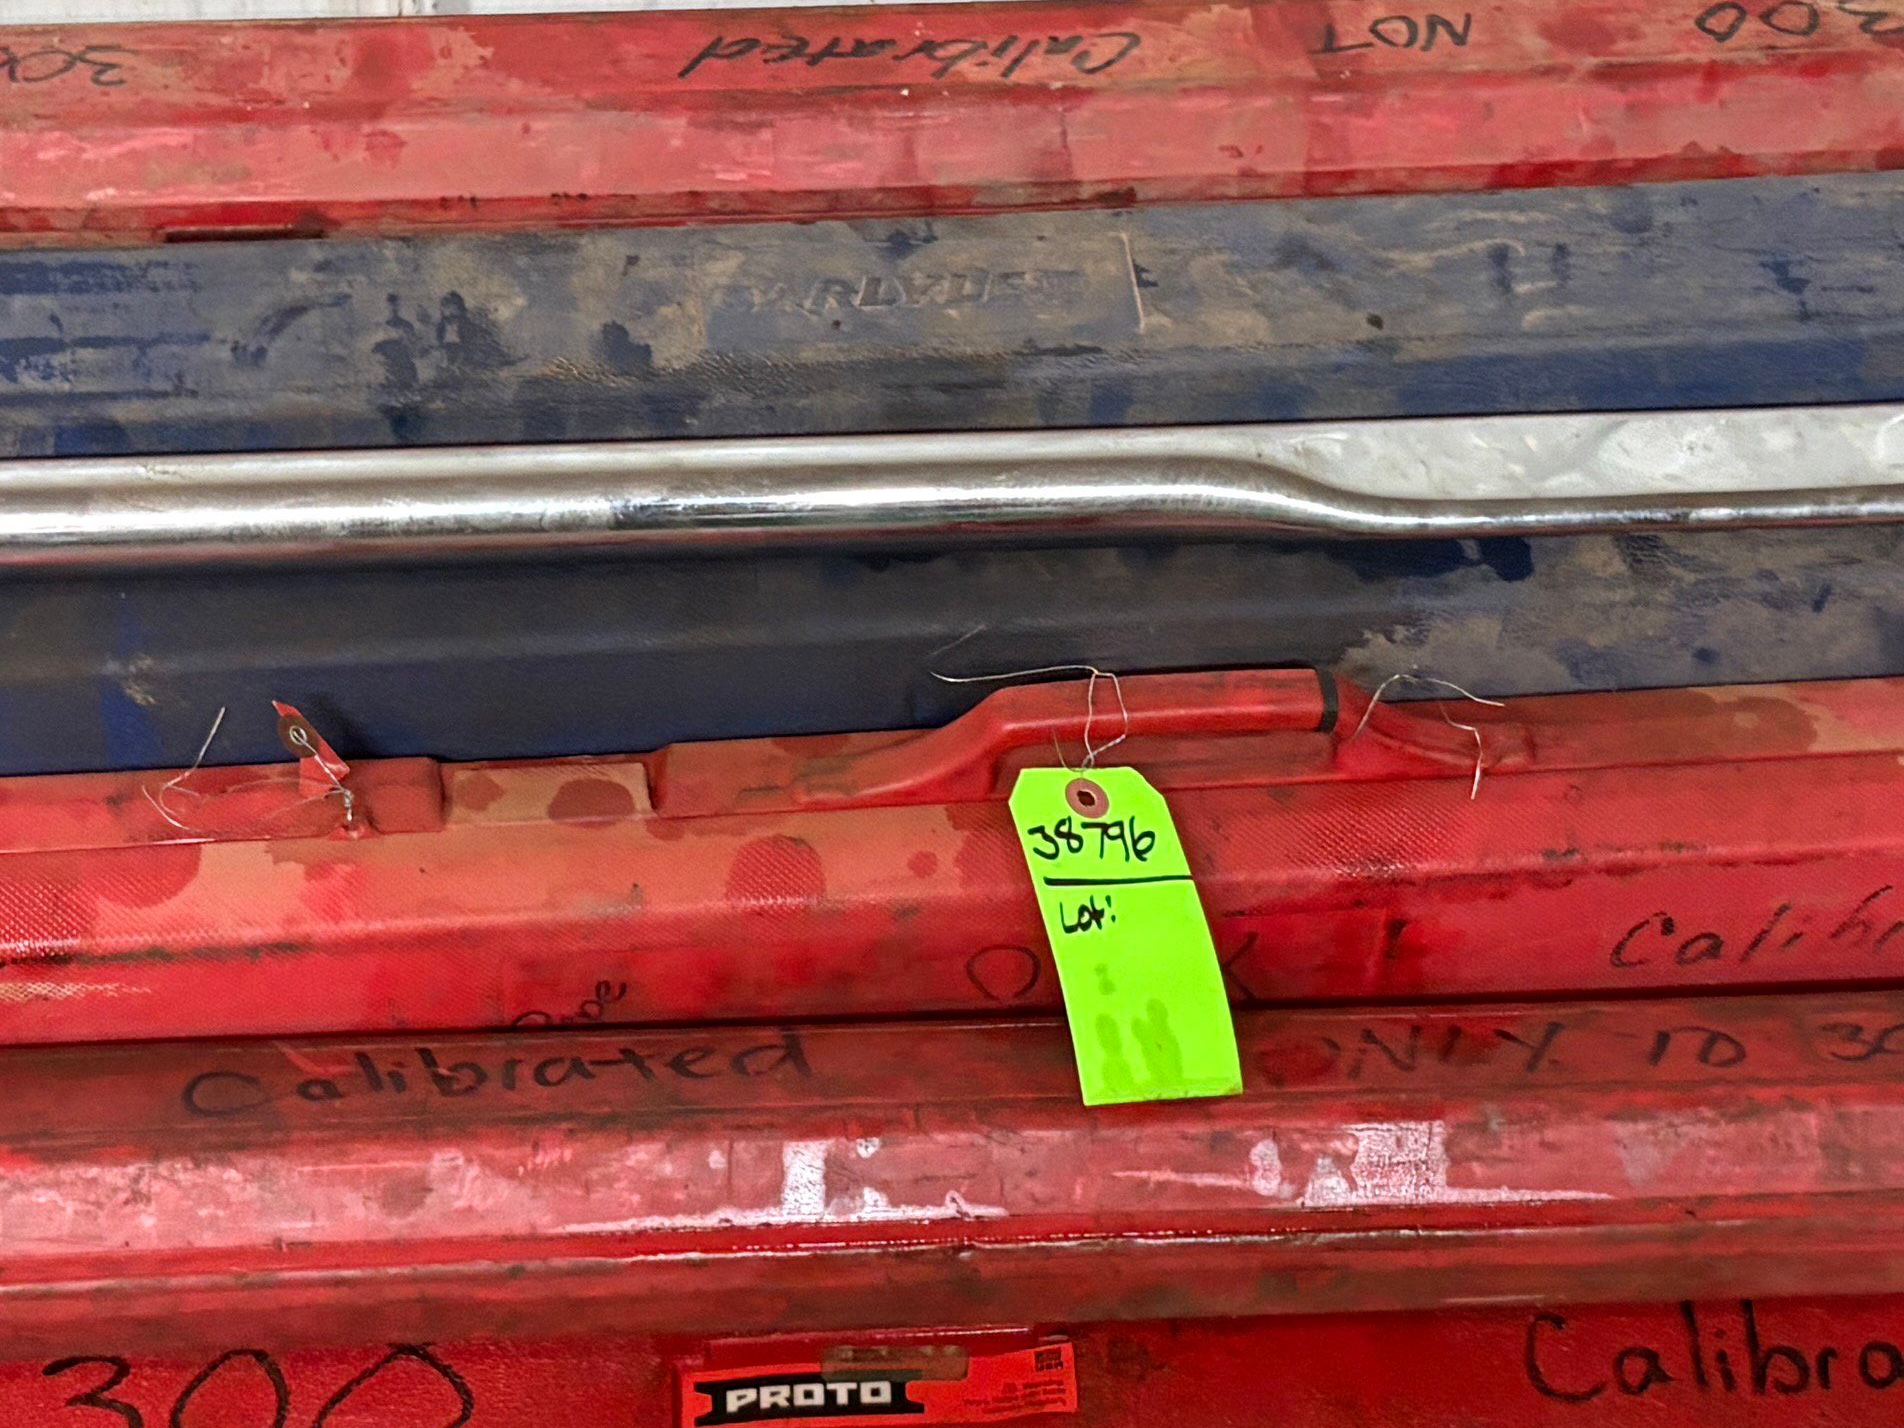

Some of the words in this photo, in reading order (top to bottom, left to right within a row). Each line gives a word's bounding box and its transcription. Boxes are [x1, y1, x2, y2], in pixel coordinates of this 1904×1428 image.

[678, 30, 1142, 79] Calibrated
[1311, 11, 1472, 57] NOT
[1027, 815, 1156, 863] 38796
[181, 1032, 815, 1118] Calibrated
[725, 1379, 893, 1414] PROTO
